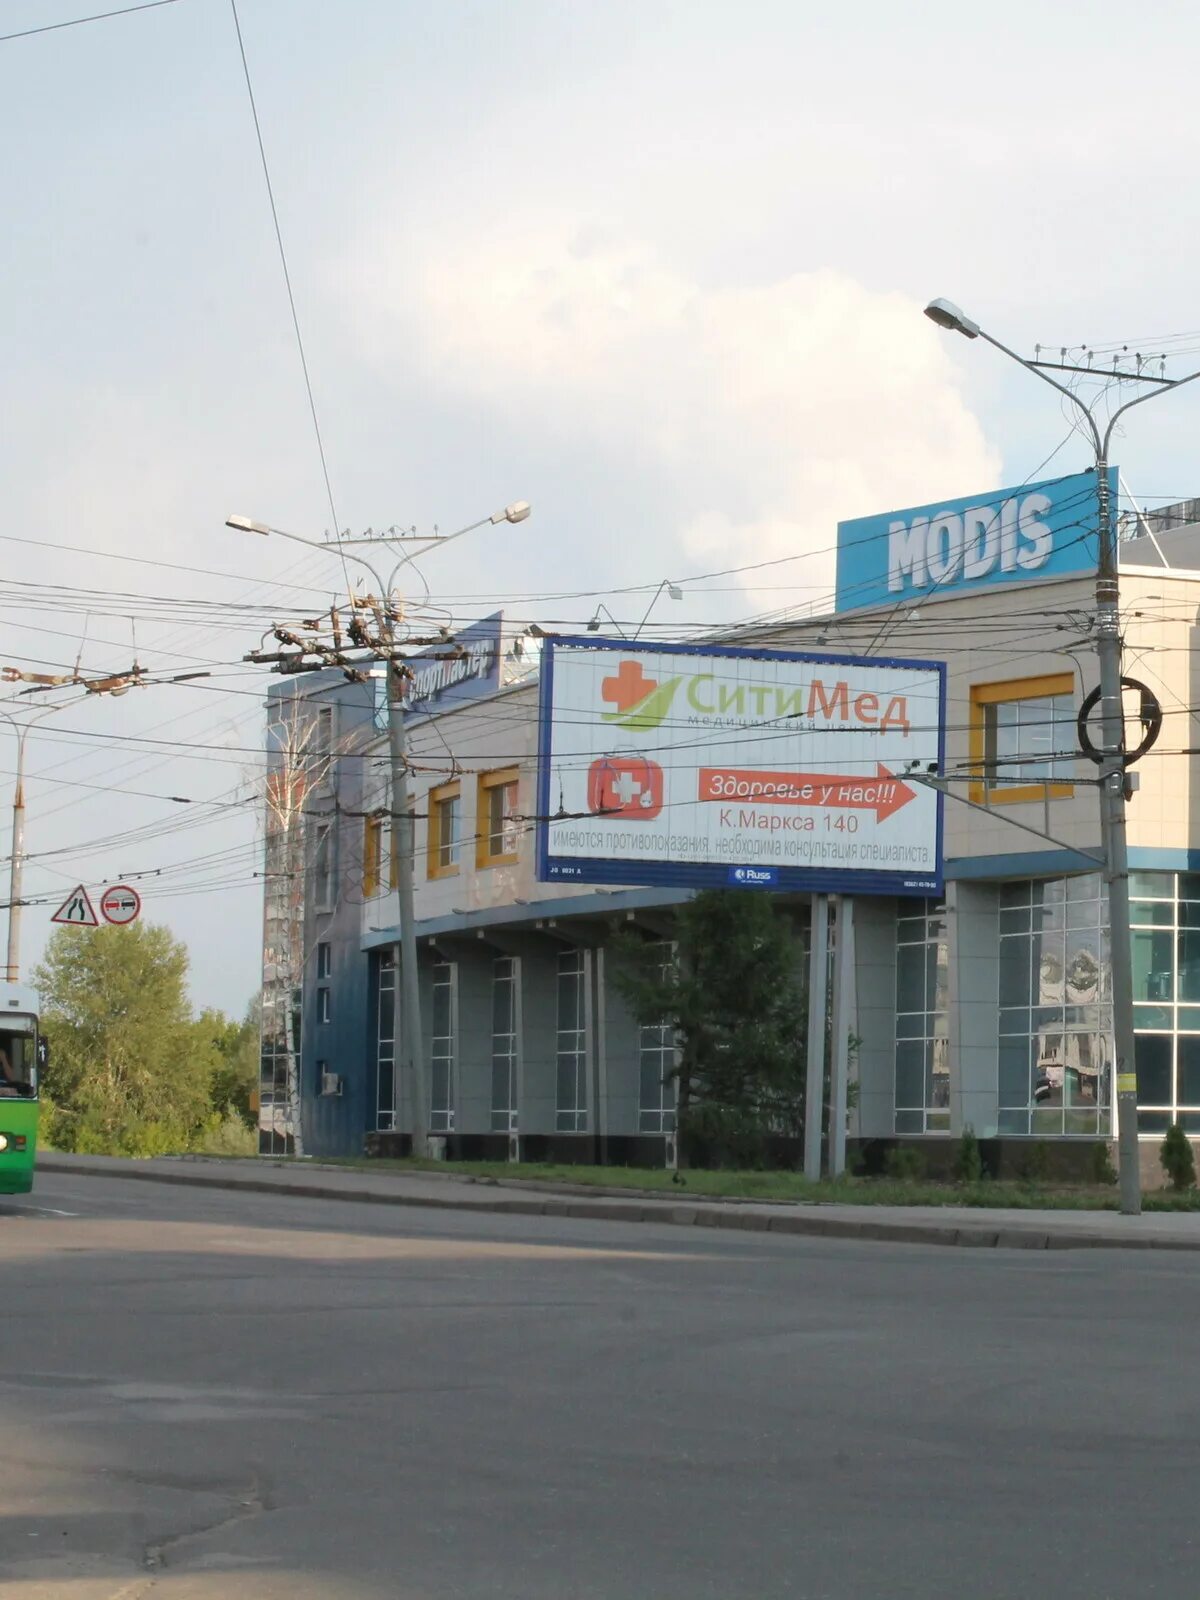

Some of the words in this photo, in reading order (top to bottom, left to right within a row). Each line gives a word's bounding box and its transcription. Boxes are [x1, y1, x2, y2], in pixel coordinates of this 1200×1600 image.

[887, 494, 1053, 592] MODIS
[687, 673, 910, 737] СитиМед
[687, 716, 816, 731] медицинский
[709, 774, 814, 800] Здоровье
[819, 785, 832, 805] у
[838, 784, 897, 804] нас!!!
[719, 808, 815, 833] К.Маркса
[823, 813, 858, 833] 140
[715, 834, 782, 860] необходима
[783, 838, 858, 863] консультация
[746, 869, 771, 879] Russ
